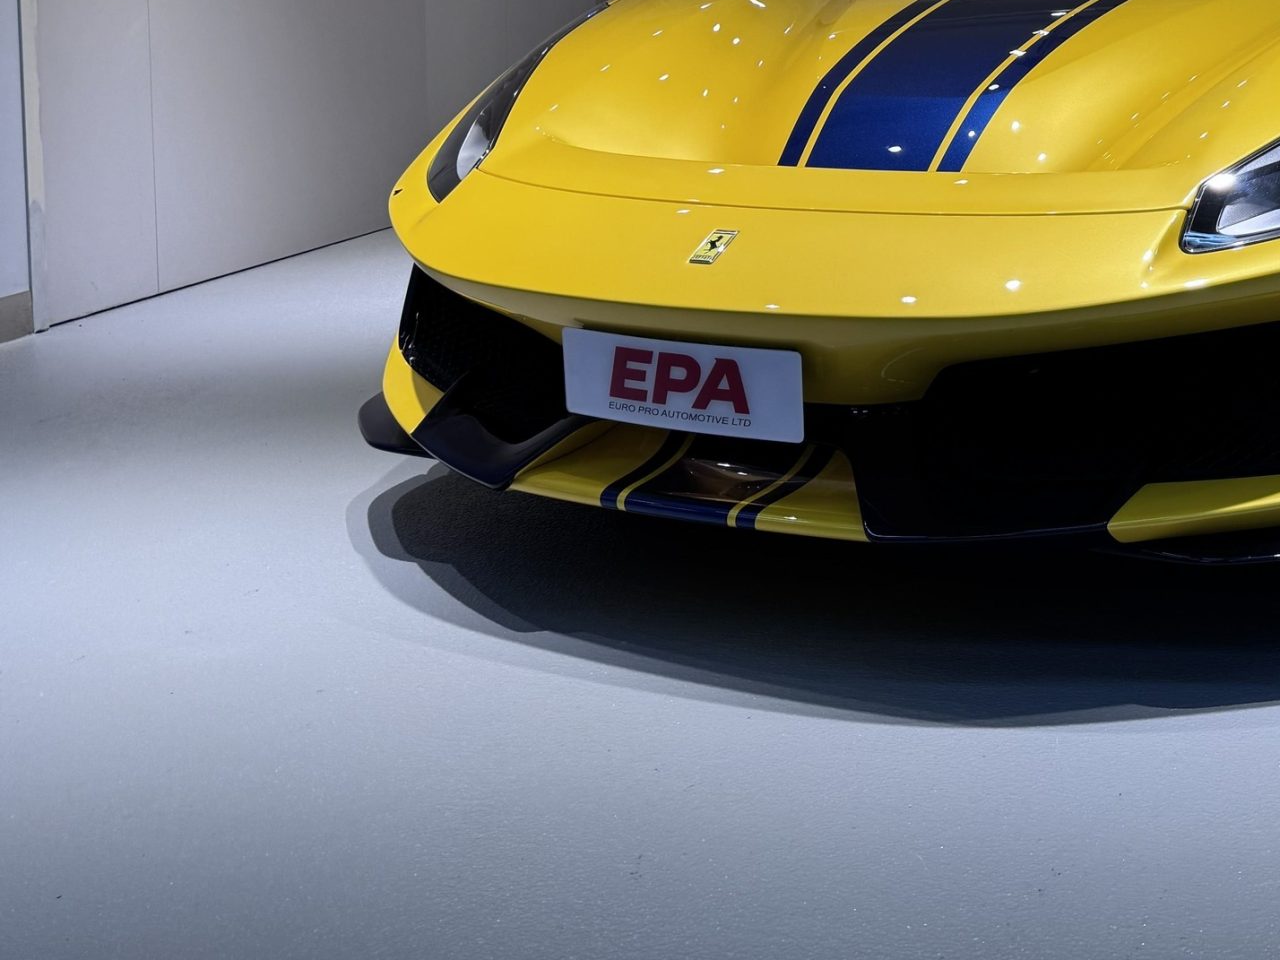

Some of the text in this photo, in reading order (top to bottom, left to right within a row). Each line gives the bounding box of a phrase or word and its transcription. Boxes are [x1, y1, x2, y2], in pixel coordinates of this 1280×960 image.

[609, 346, 751, 415] EPA
[608, 400, 752, 428] EURO PRO AUTOMOTIVE LTD
